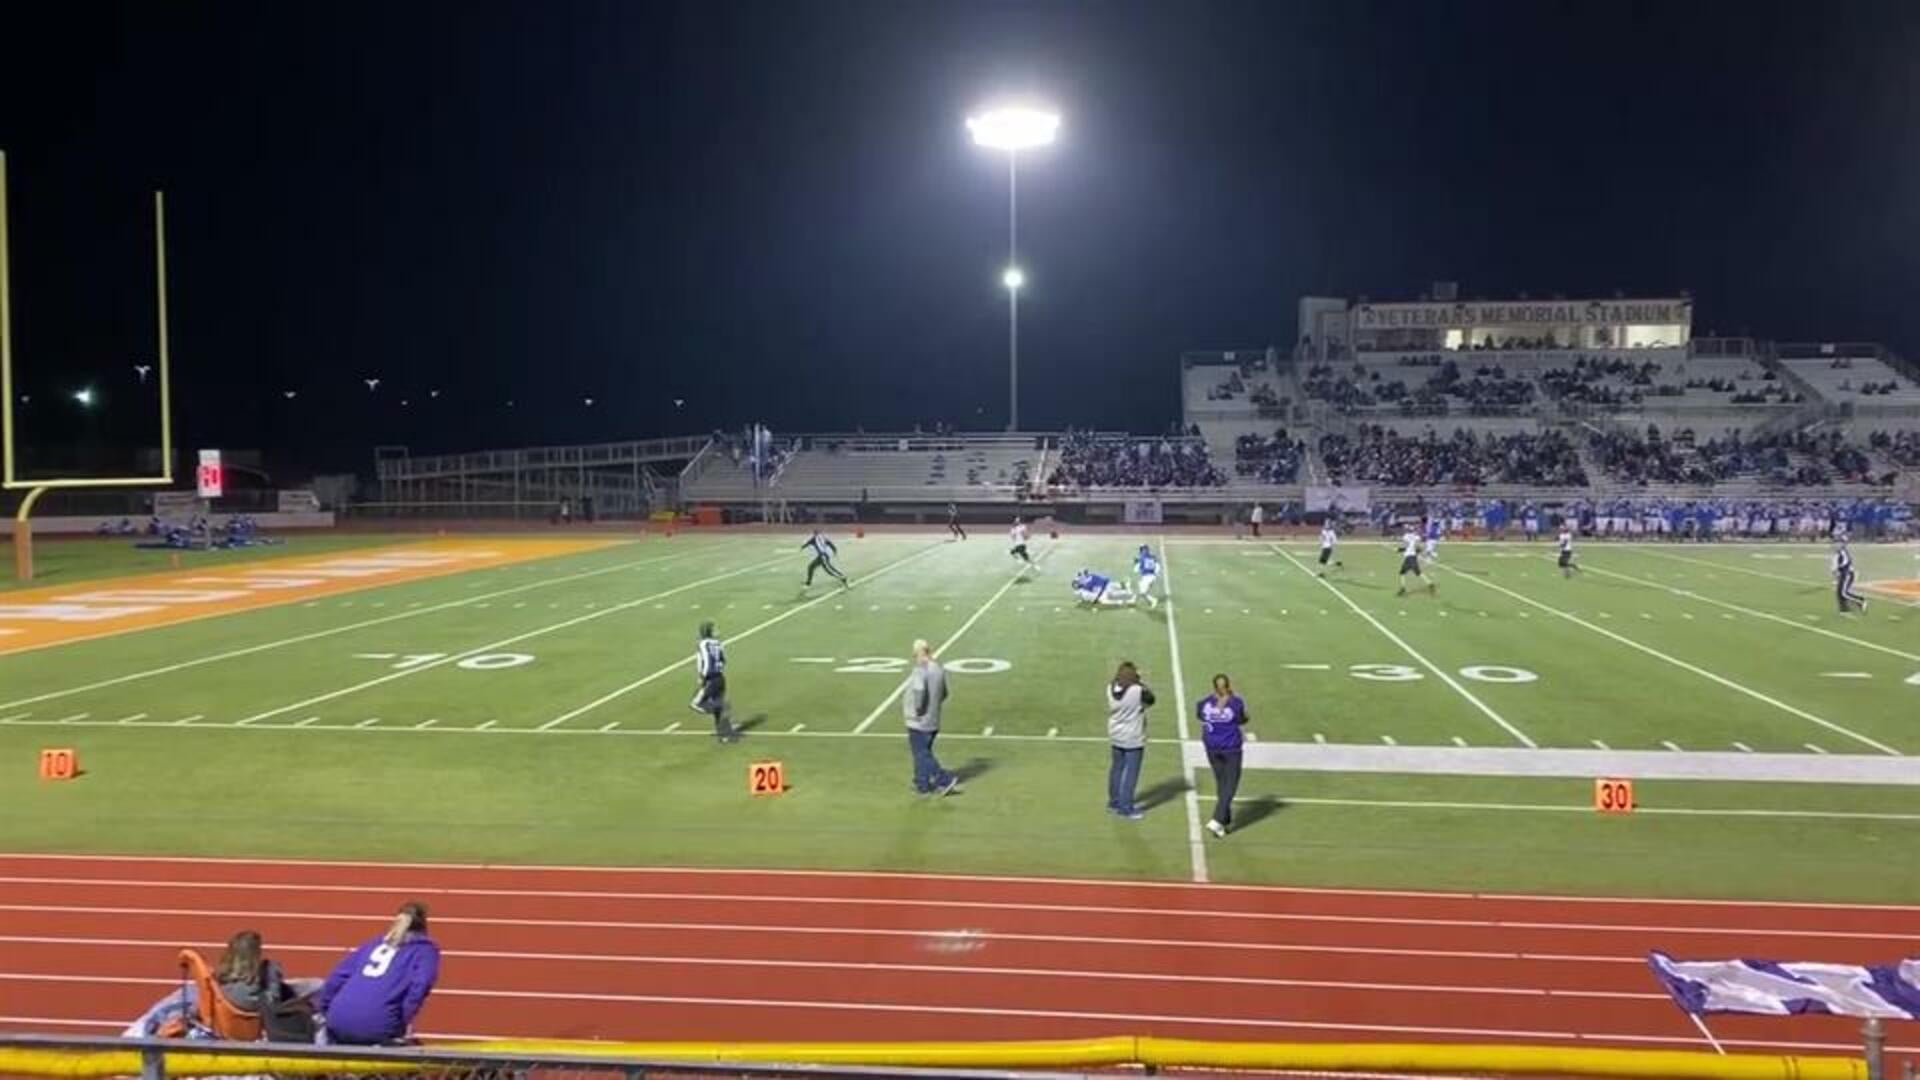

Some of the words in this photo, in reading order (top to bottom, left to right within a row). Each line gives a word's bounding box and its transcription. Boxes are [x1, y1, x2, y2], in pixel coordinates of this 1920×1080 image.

[1376, 307, 1475, 325] VETERANS
[1481, 305, 1578, 322] MEMORIAL
[1585, 303, 1671, 321] STADIUM
[46, 751, 70, 777] 10
[755, 766, 779, 791] 20
[1602, 783, 1628, 809] 30
[362, 943, 397, 977] 9
